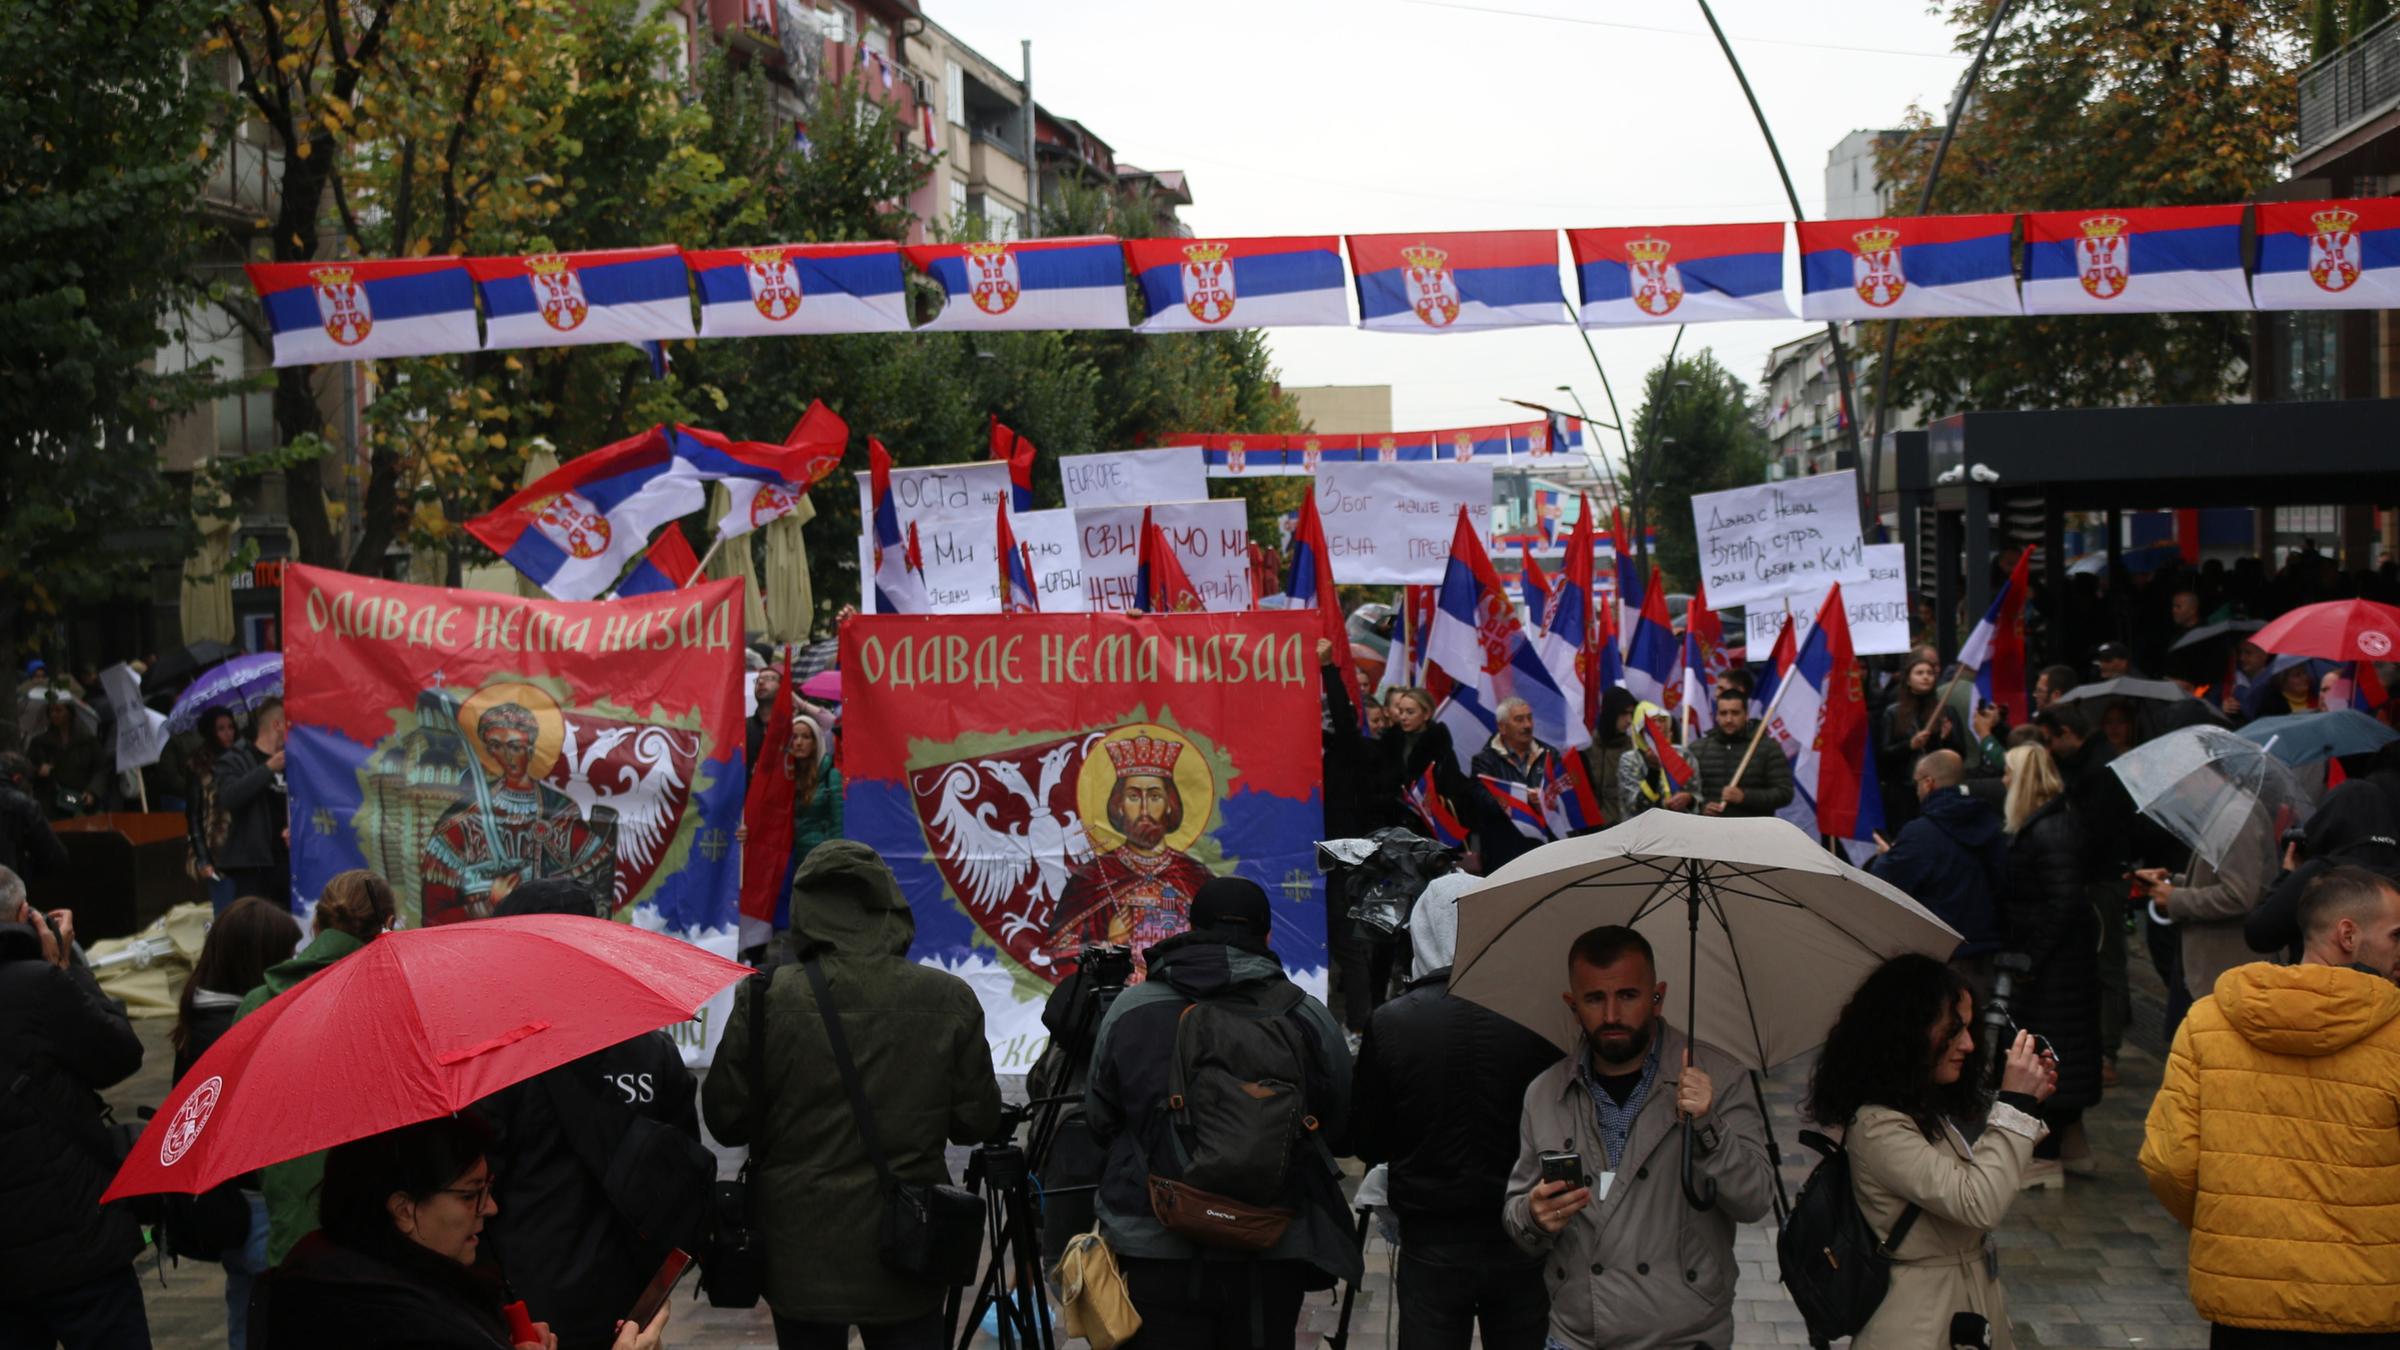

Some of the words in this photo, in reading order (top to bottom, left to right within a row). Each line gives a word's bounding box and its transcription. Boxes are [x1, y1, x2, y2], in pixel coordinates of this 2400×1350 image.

[474, 606, 593, 652] НЕМА
[600, 600, 731, 652] НАЗАД
[1040, 633, 1159, 684] НЕМА
[1175, 632, 1307, 689] НАЗАД
